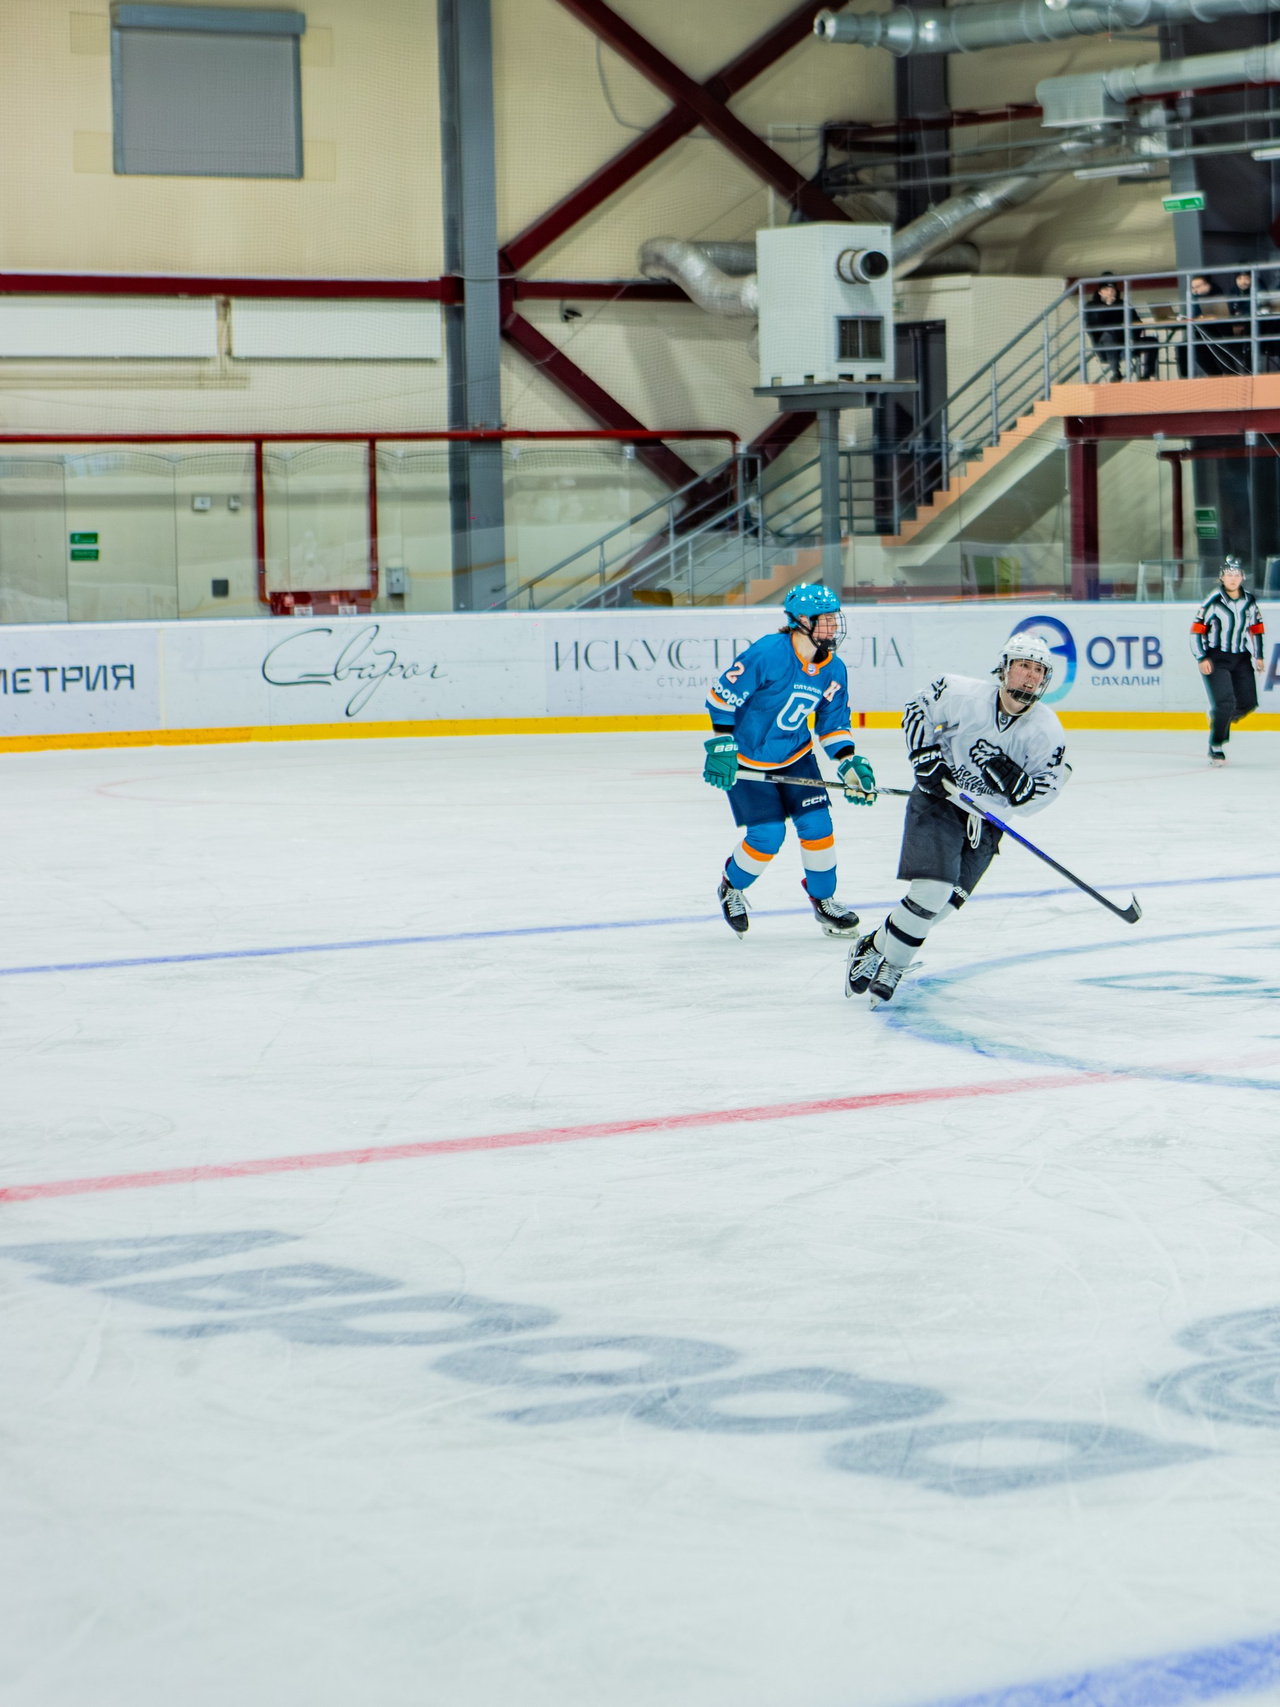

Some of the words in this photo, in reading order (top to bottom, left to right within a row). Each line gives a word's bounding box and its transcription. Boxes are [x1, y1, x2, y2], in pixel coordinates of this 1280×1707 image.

[1086, 636, 1163, 670] ОТВ
[1091, 675, 1161, 686] САХАЛИН
[911, 751, 942, 768] CCM
[802, 795, 827, 807] CCM
[0, 1229, 1222, 1497] Аврора
